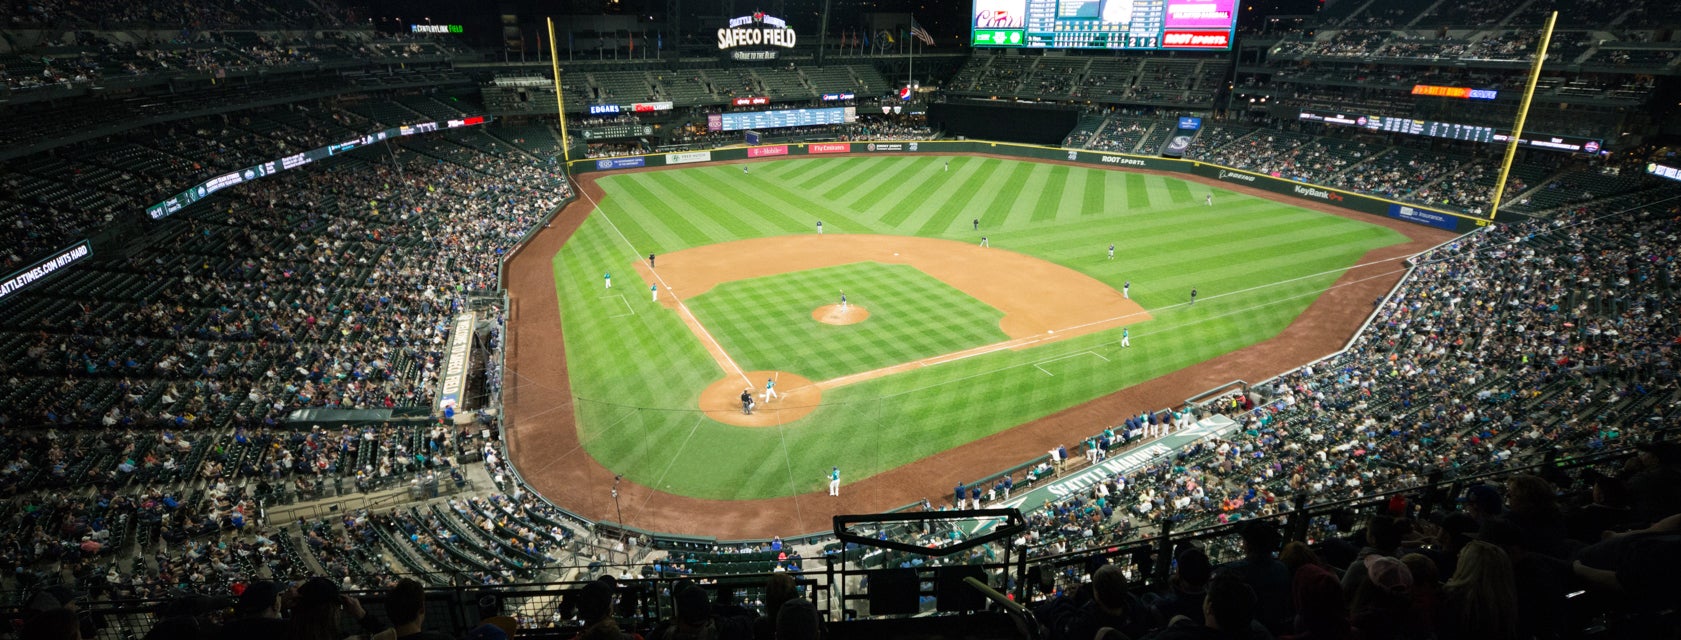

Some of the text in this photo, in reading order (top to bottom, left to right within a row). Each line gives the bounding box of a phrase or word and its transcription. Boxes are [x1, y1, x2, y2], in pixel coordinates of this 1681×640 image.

[729, 16, 752, 28] SEATTLE
[448, 24, 463, 33] FIELD
[717, 28, 796, 49] SAFECO FIELD
[1129, 37, 1137, 47] 2
[1140, 37, 1146, 47] 1
[1148, 37, 1157, 47] 2
[1164, 33, 1193, 45] ROOT
[739, 52, 751, 60] TRUE
[764, 51, 776, 59] BLUE
[814, 144, 845, 153] Fly Emirates
[1102, 155, 1121, 163] ROOT
[1228, 172, 1256, 182] BOEING
[1294, 185, 1330, 199] KeyBank
[56, 252, 72, 268] HITS
[70, 245, 88, 261] HARD
[453, 320, 470, 345] WELCOME
[448, 353, 464, 375] SAFECO
[443, 375, 461, 394] FIELD
[1102, 443, 1172, 474] MARINERS
